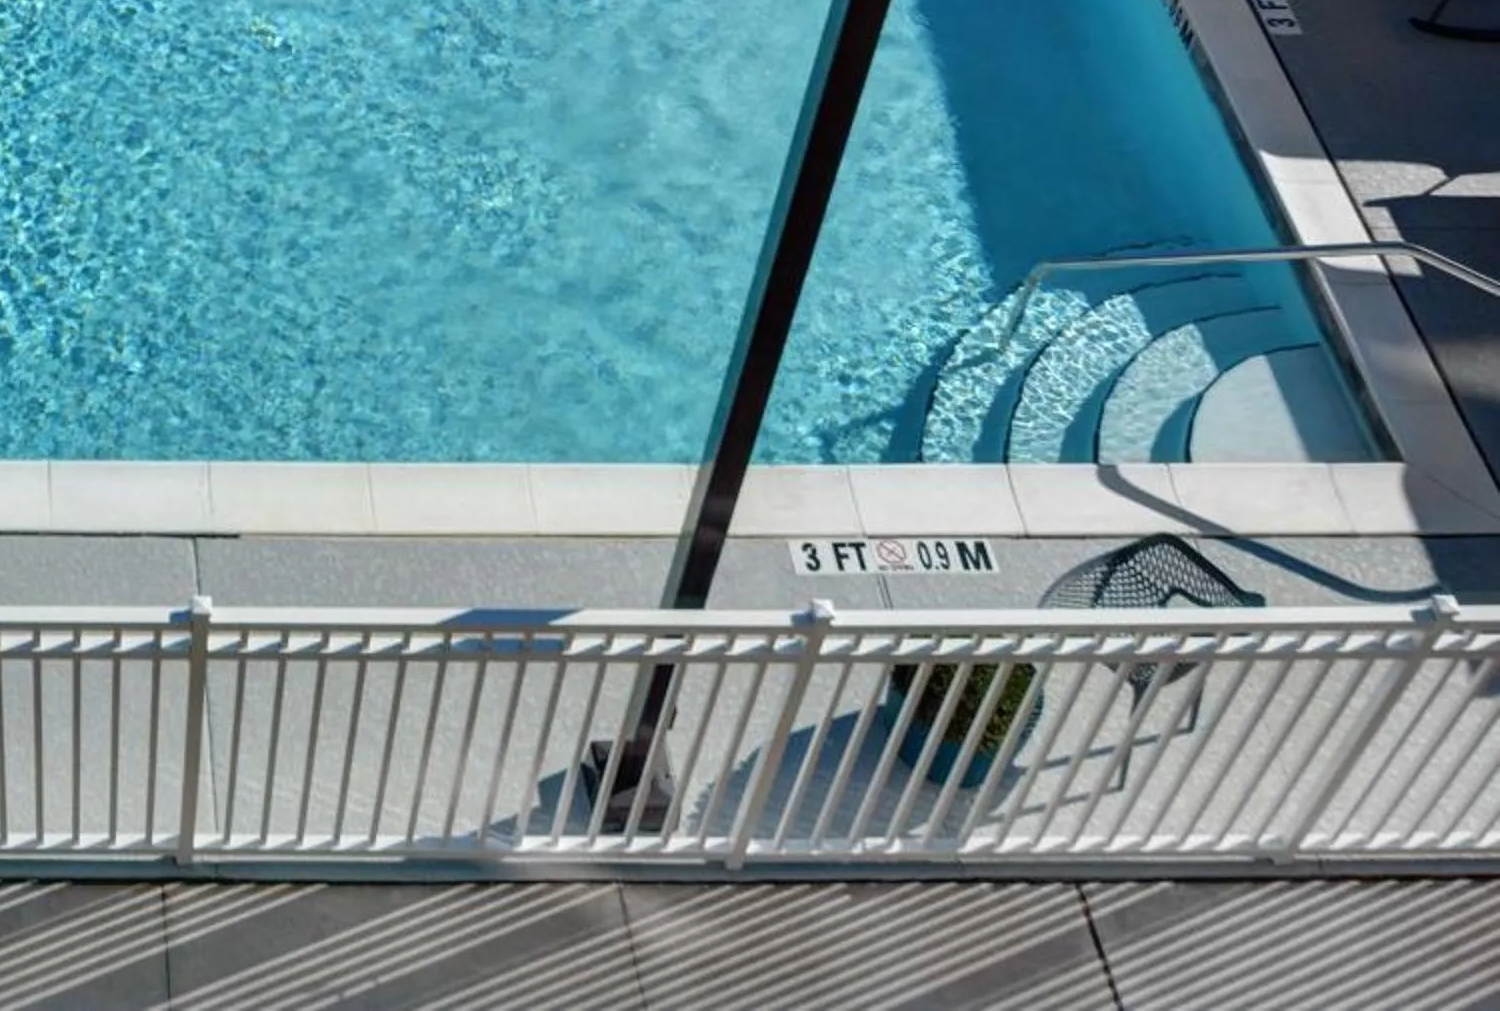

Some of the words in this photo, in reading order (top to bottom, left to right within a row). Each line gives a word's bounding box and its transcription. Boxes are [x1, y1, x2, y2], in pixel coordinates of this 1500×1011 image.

[1268, 19, 1295, 27] 3
[802, 543, 820, 571] 3
[832, 542, 867, 570] FT
[917, 541, 949, 570] 0.9
[955, 541, 992, 570] M
